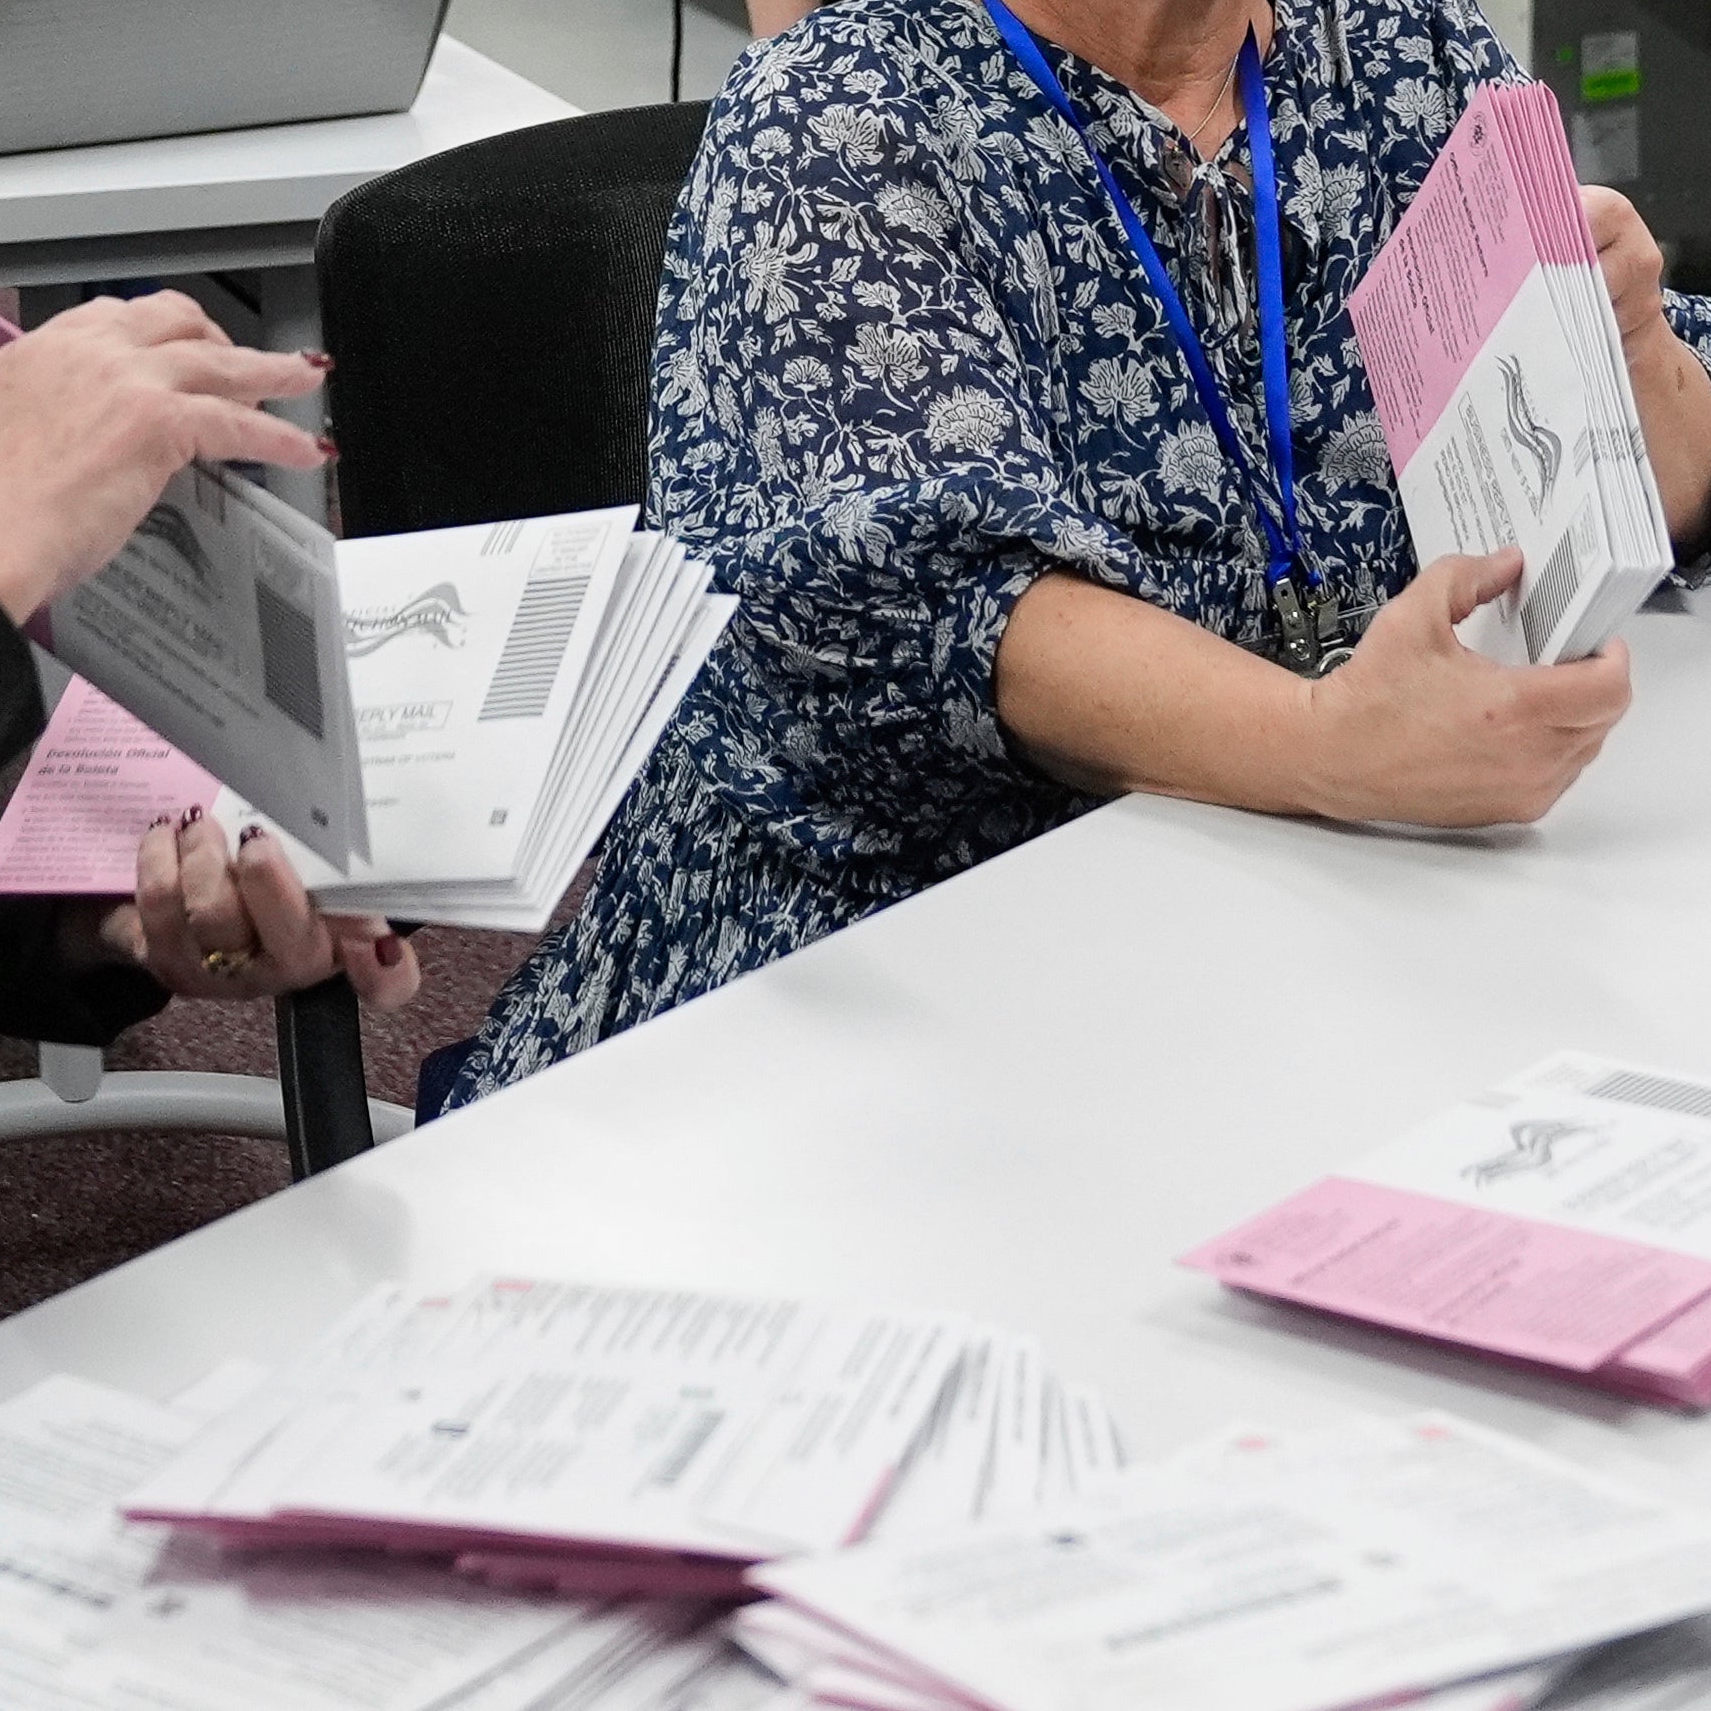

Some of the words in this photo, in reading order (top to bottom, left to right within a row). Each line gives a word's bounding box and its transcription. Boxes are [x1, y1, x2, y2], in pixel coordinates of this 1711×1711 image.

[1448, 149, 1464, 196] Official
[1462, 194, 1476, 235] Ballot
[1473, 232, 1489, 279] Return
[400, 704, 437, 721] MAIL
